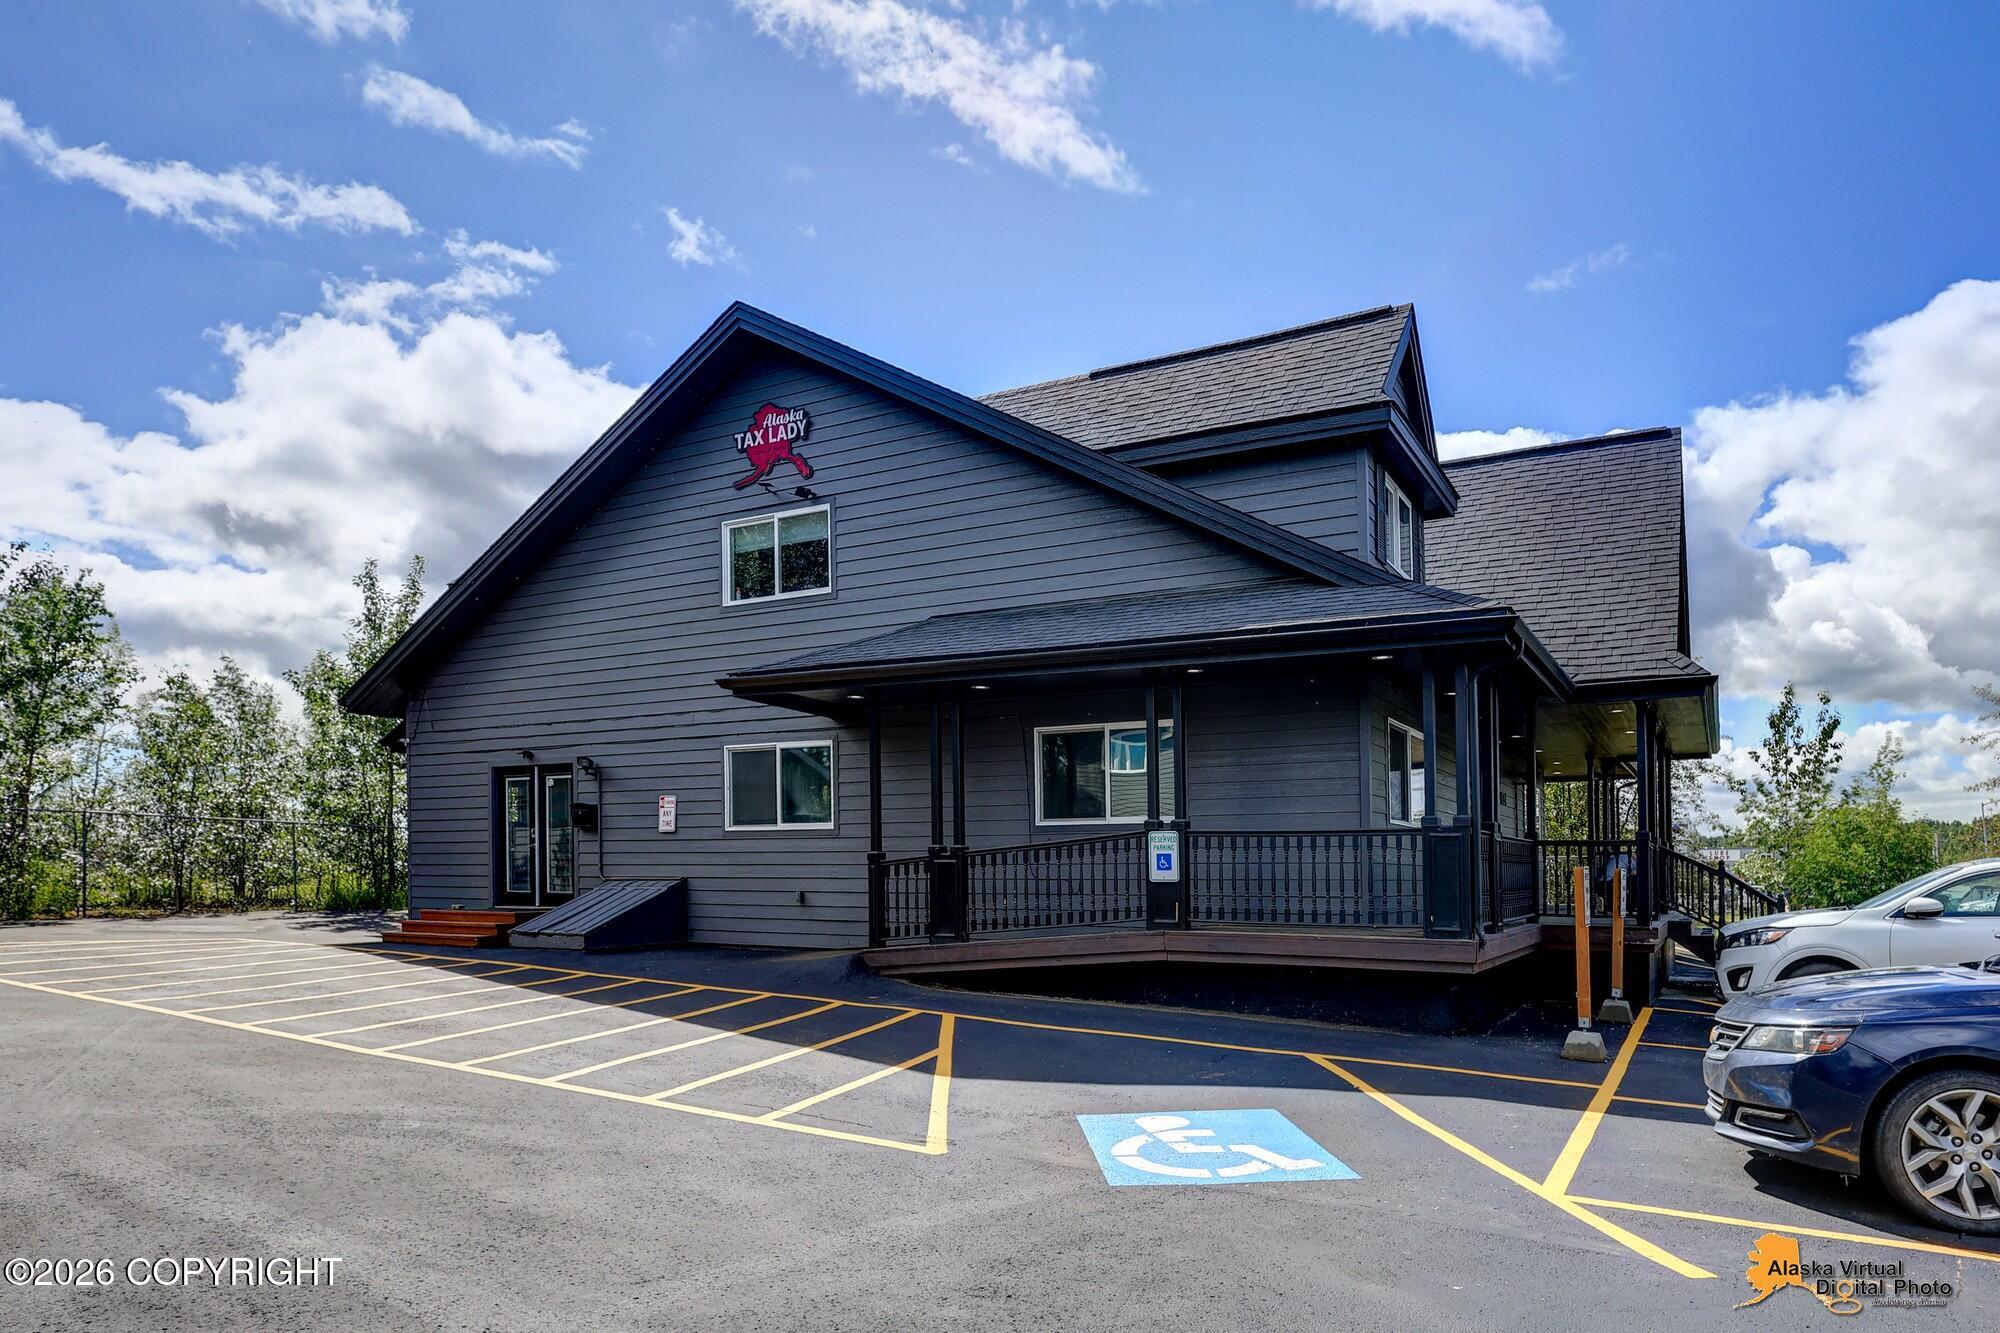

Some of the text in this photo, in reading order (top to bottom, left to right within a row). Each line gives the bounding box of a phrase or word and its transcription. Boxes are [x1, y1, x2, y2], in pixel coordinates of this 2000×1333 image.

[763, 409, 804, 429] Alaska
[734, 419, 807, 450] TAX LADY
[662, 809, 672, 817] ANY
[661, 819, 673, 828] TIME
[1151, 835, 1177, 843] RESERVED
